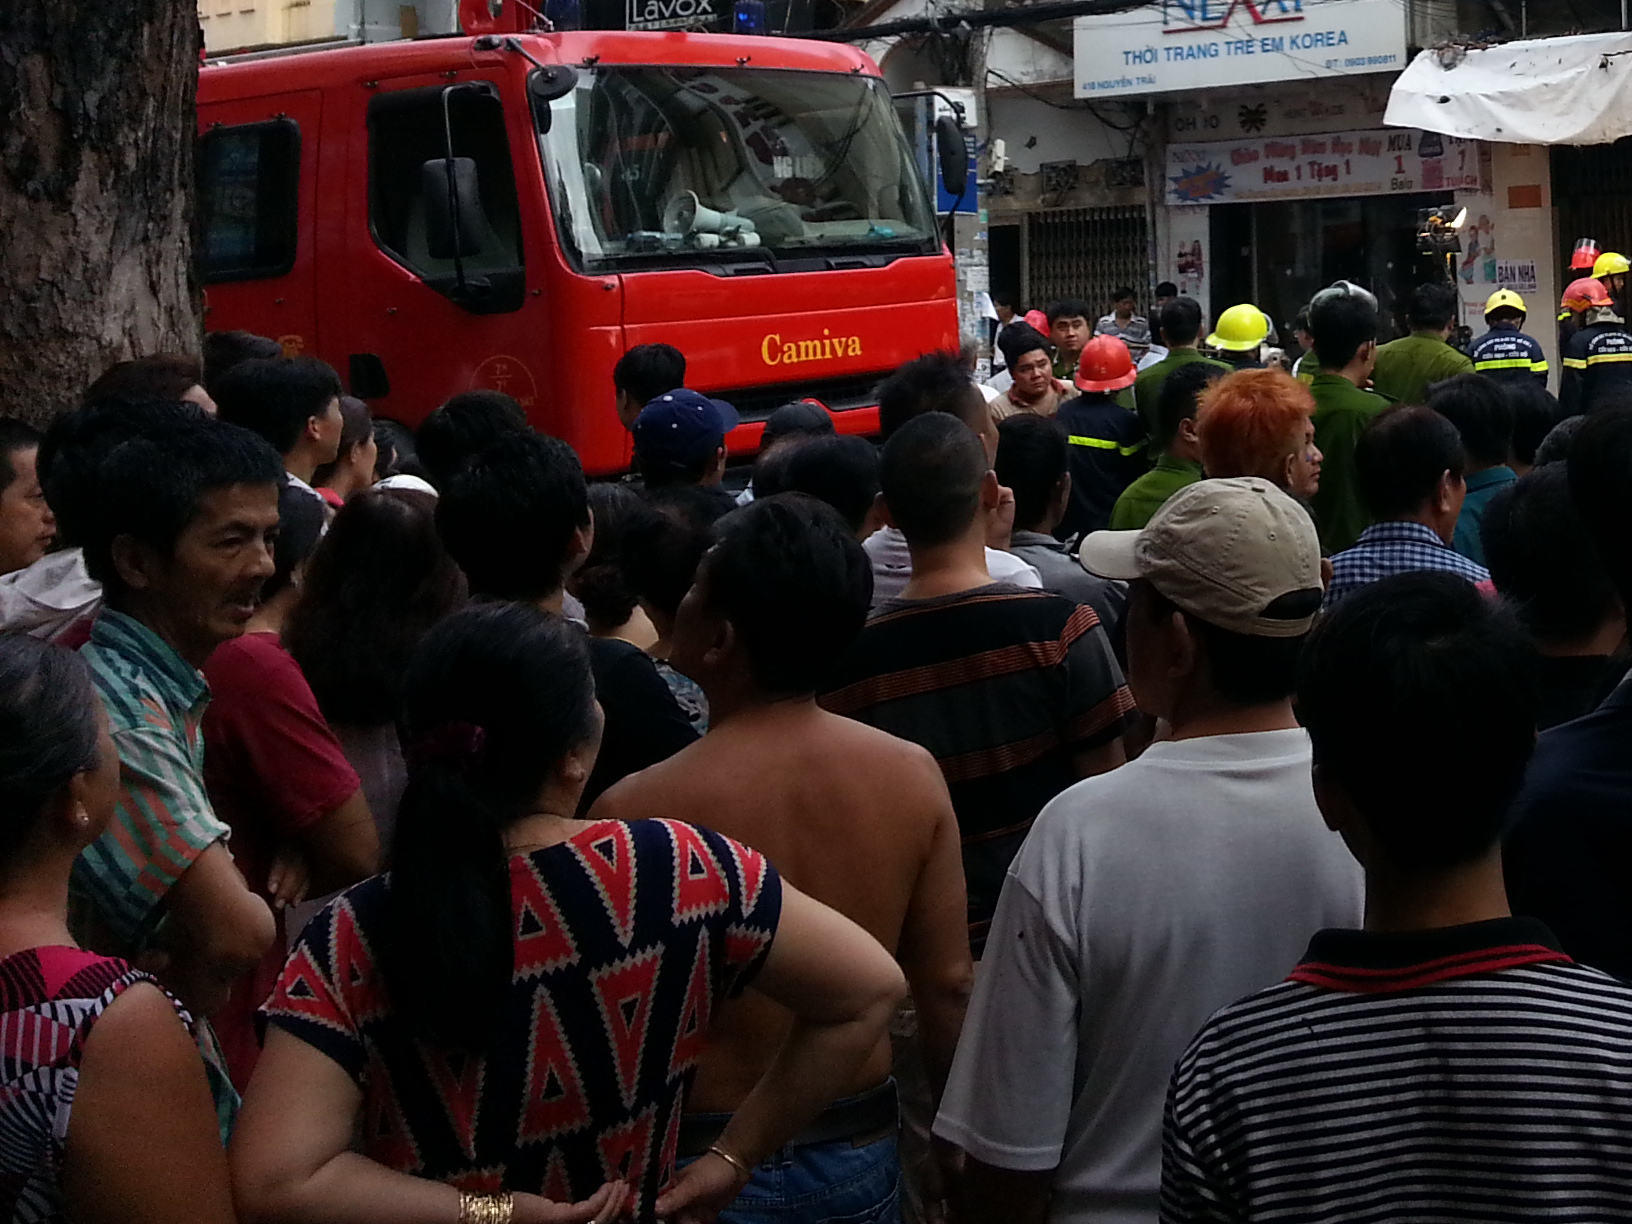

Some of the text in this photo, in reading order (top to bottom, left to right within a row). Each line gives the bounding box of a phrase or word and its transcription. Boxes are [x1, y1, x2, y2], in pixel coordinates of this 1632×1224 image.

[1123, 44, 1159, 66] THỜI
[1164, 42, 1219, 62] TRANG
[1261, 35, 1285, 53] EM
[1290, 30, 1349, 50] KOREA
[761, 328, 862, 366] Camiva
